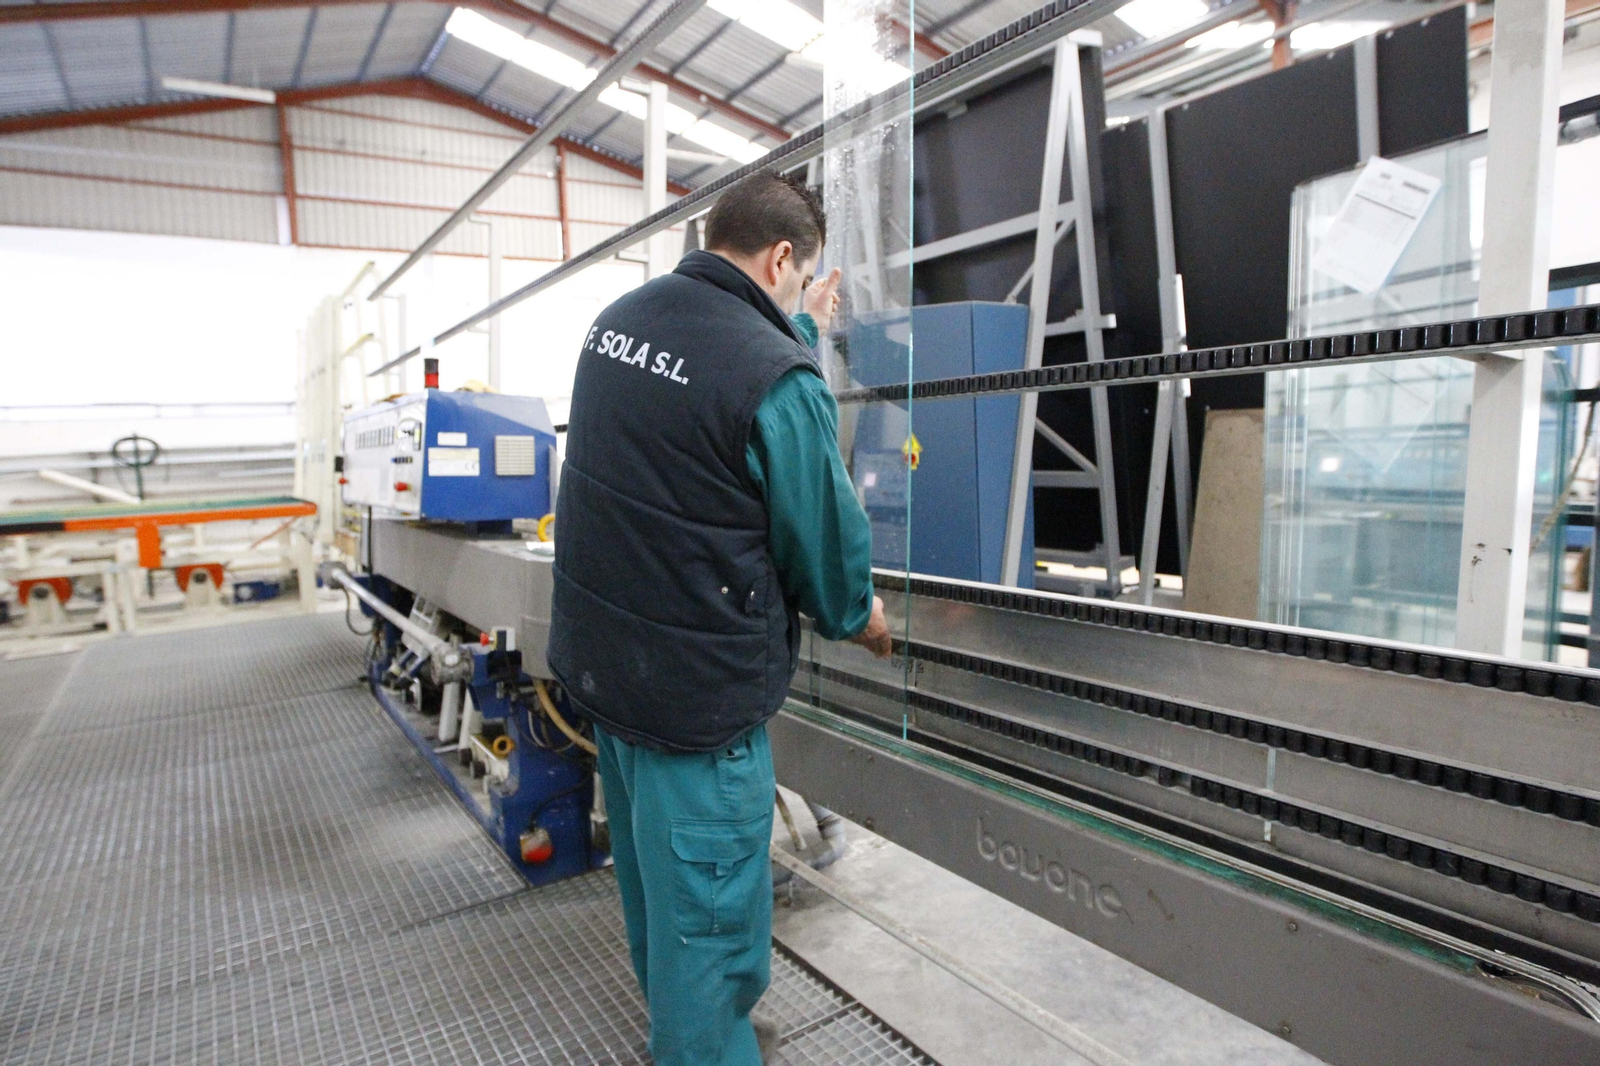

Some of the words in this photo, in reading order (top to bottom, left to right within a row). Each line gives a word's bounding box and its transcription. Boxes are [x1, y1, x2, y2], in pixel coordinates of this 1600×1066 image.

[584, 326, 599, 350] F.
[597, 330, 650, 369] SOLA
[650, 351, 689, 385] S.L.
